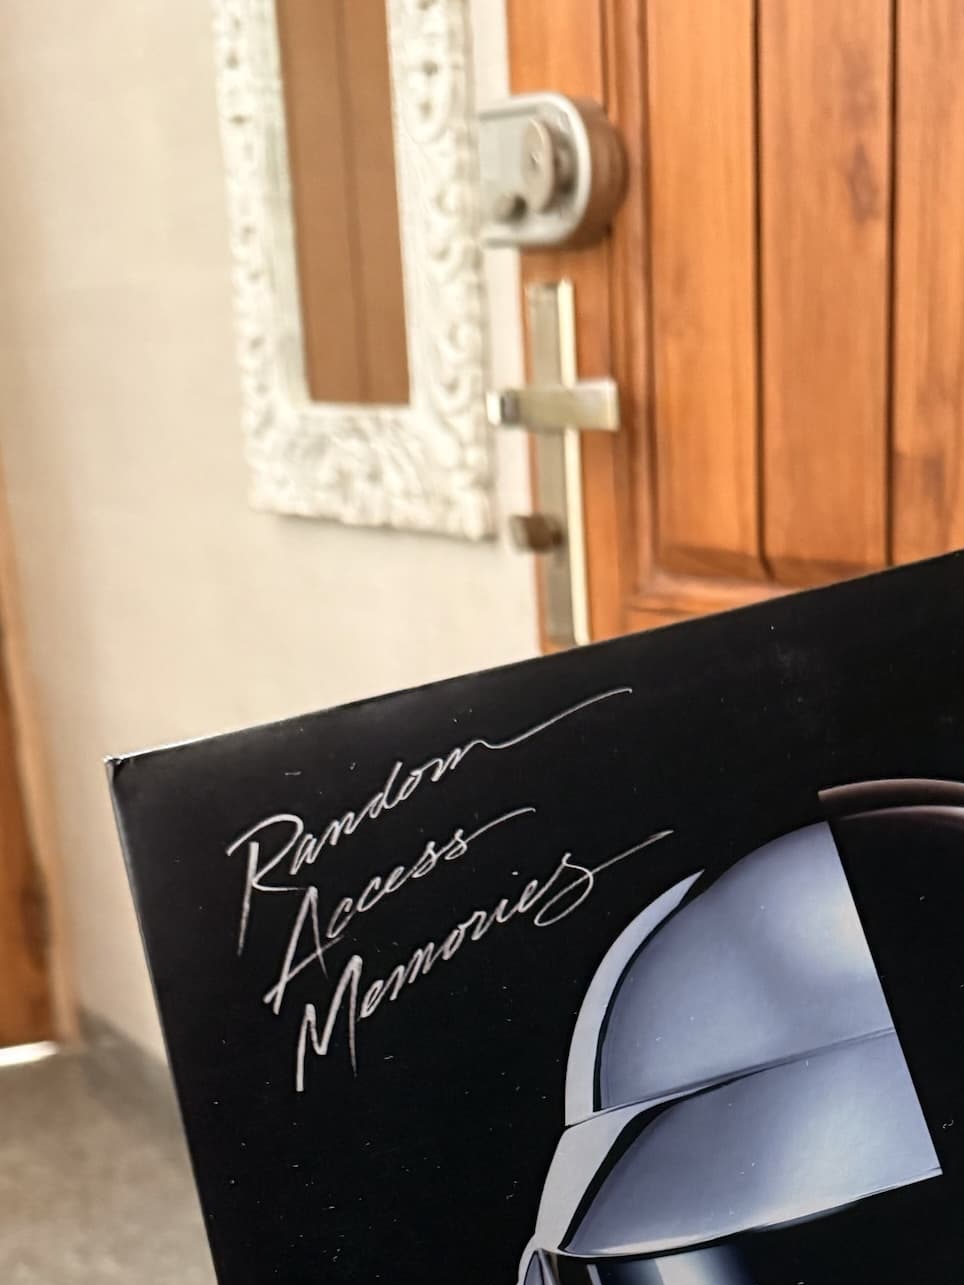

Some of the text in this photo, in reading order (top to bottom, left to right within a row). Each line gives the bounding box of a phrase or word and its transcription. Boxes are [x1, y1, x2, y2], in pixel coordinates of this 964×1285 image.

[226, 687, 633, 956] Random
[263, 807, 536, 1015] Access
[296, 830, 674, 1091] Memories
